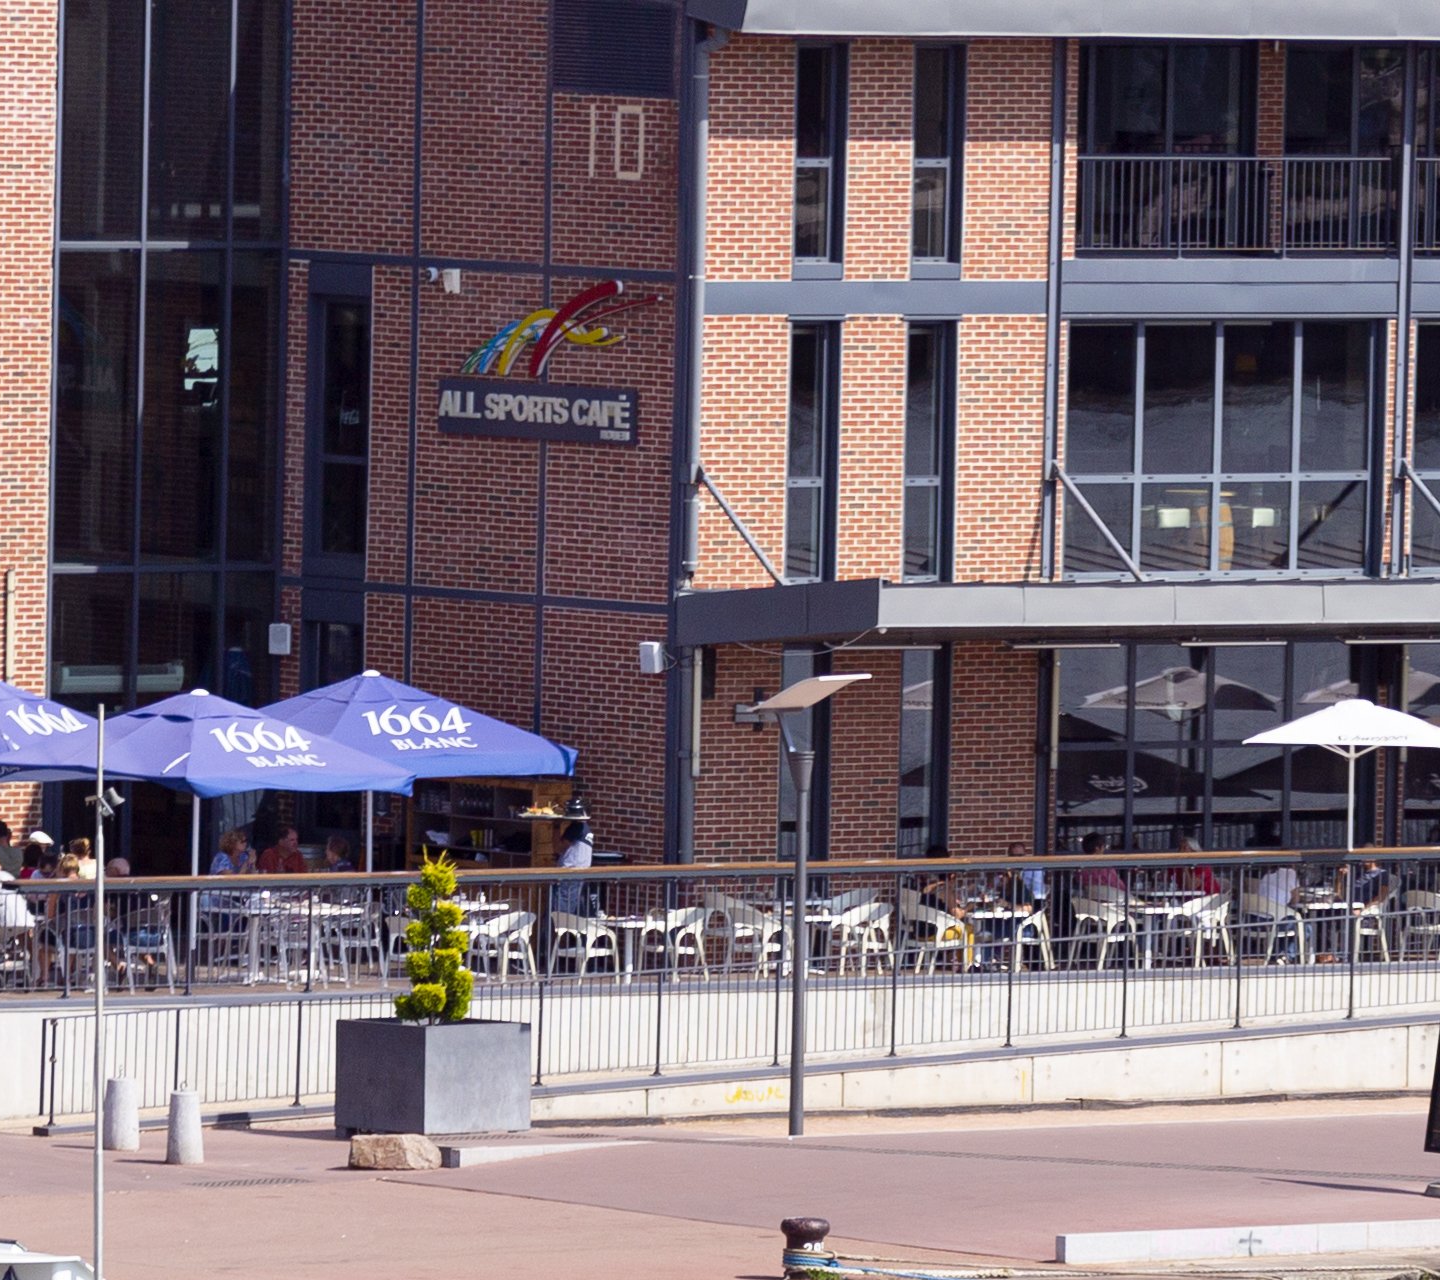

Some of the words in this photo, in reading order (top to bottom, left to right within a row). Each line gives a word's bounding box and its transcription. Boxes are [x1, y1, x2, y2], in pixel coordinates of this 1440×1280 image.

[588, 103, 644, 180] 10
[438, 389, 482, 419] ALL
[483, 392, 570, 425] SPORTS
[571, 394, 630, 430] CAFÉ
[5, 703, 89, 737] 1664
[361, 704, 472, 737] 1664
[209, 721, 312, 754] 1664
[389, 735, 479, 751] BLANC
[245, 754, 327, 769] BLANC
